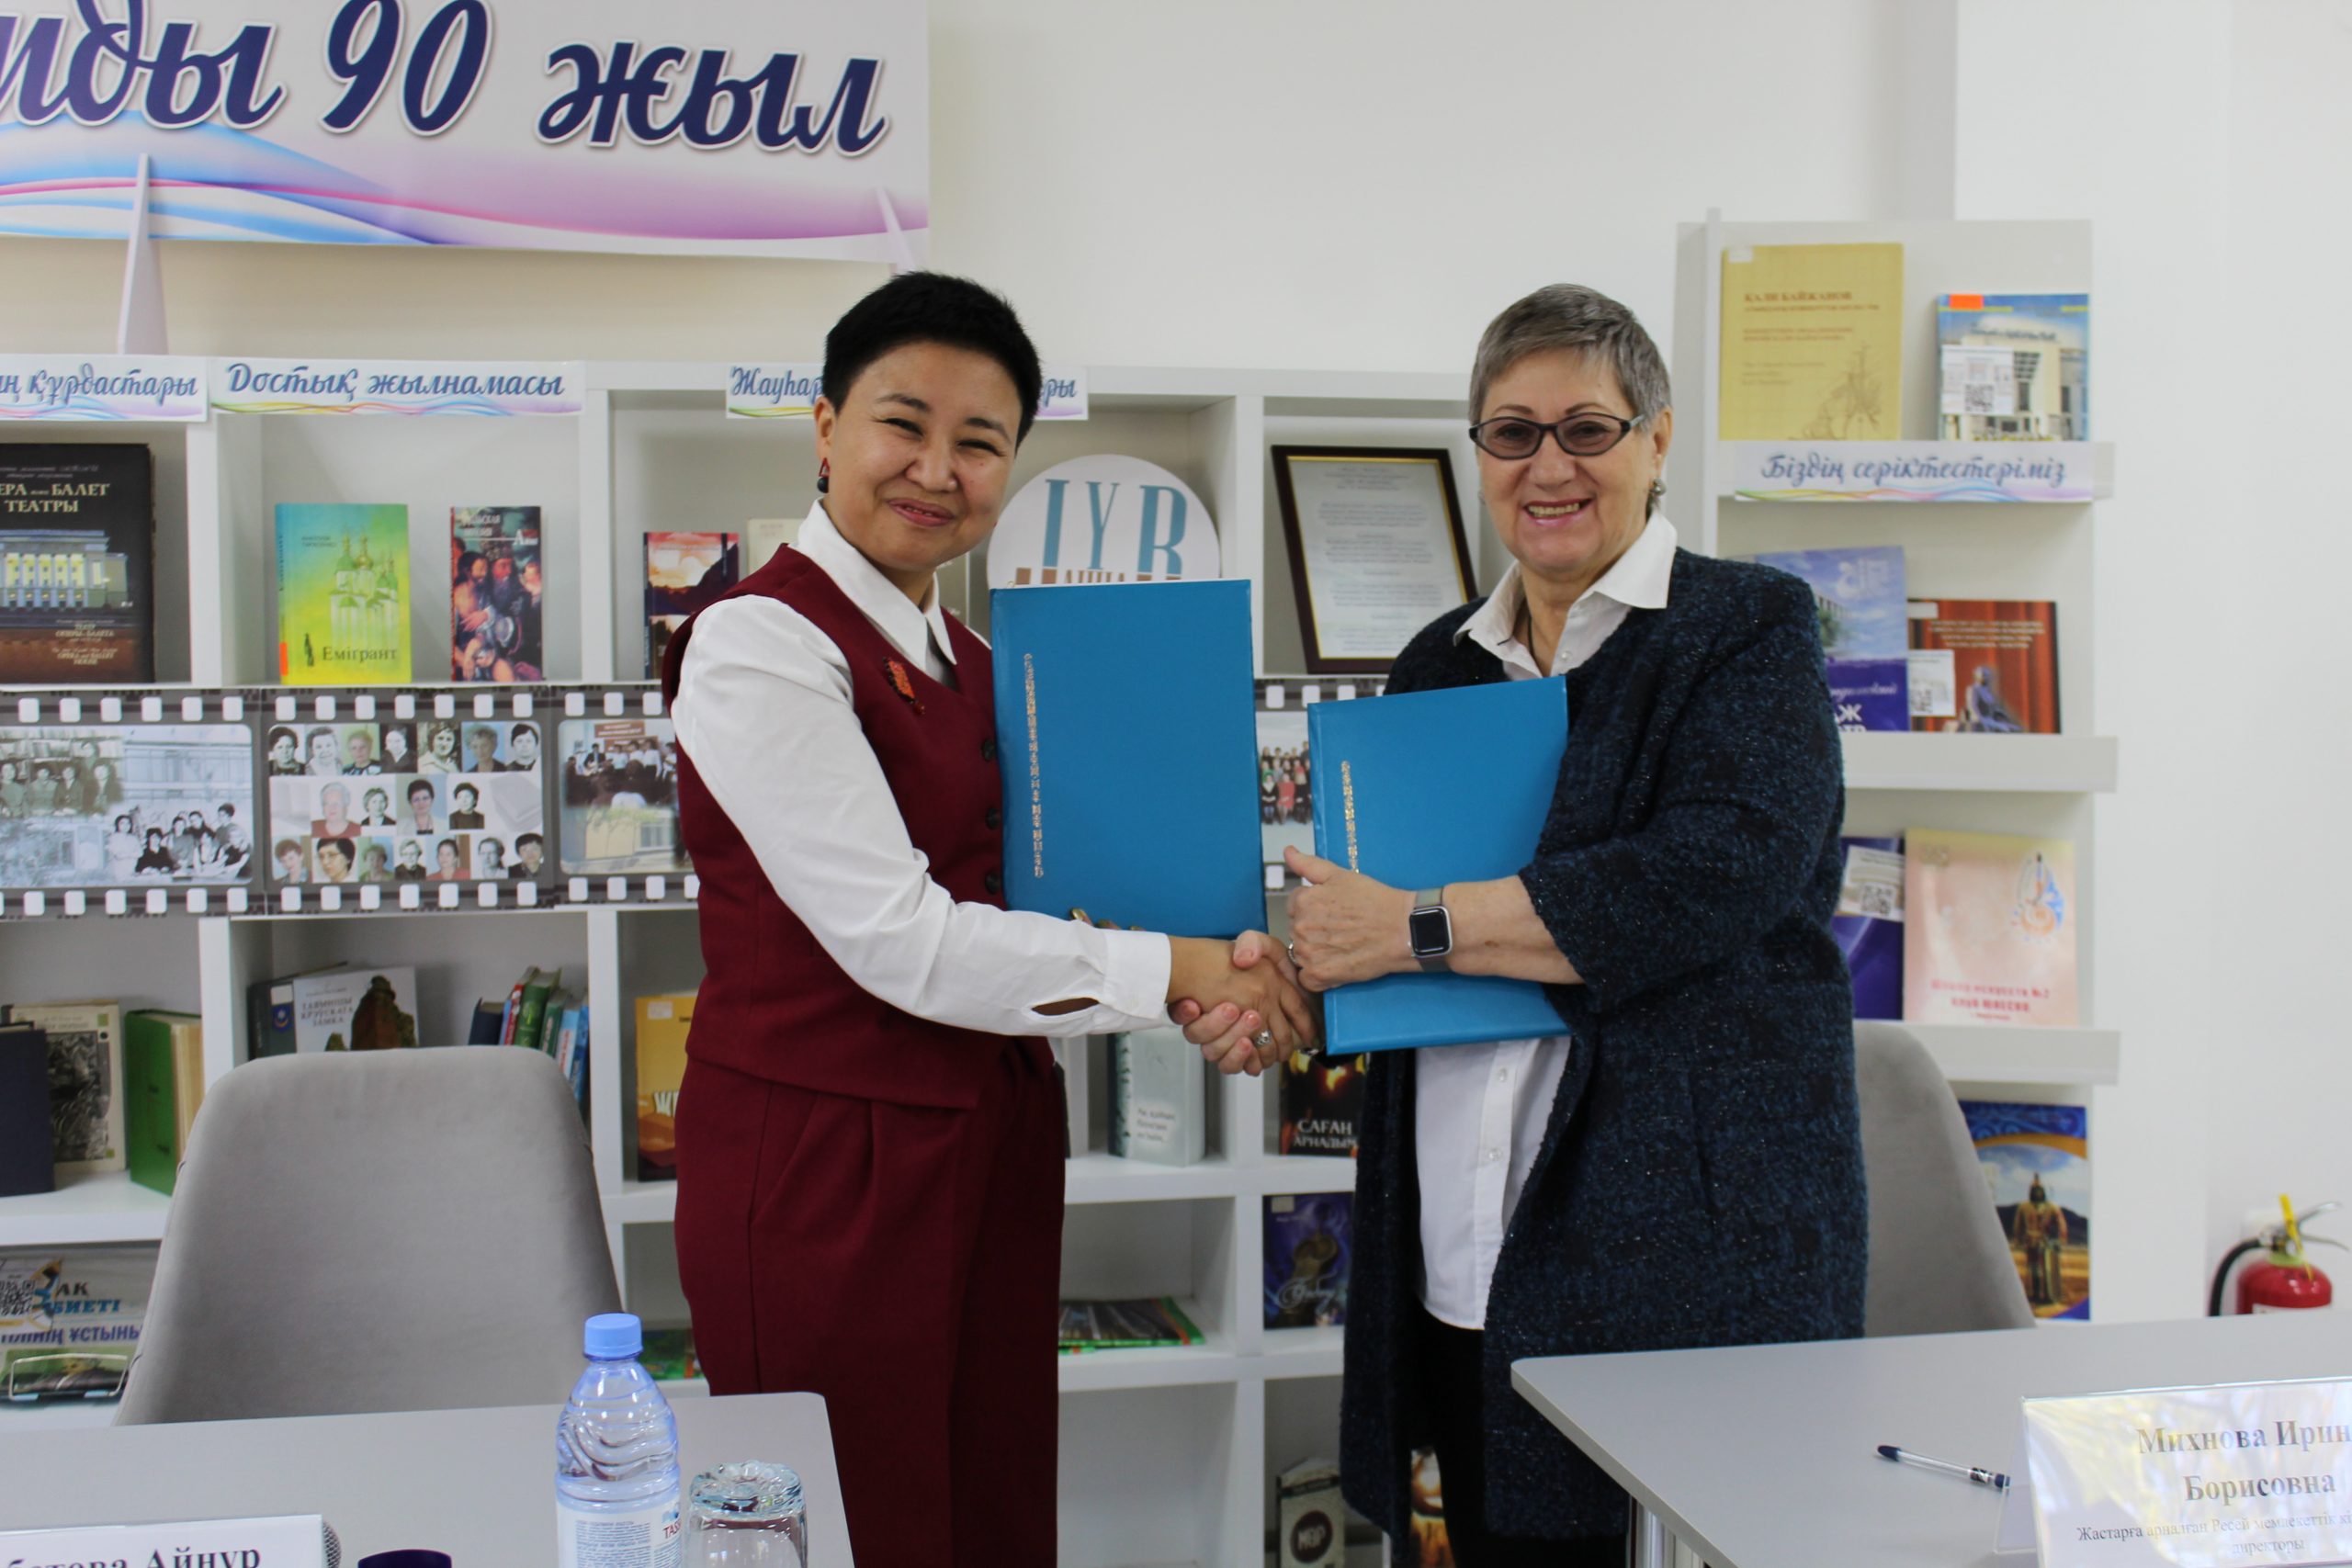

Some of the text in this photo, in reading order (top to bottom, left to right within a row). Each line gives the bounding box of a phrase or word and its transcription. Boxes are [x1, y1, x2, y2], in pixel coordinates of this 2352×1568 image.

[322, 0, 489, 132] 90
[540, 41, 888, 153] жыл
[28, 362, 198, 406] құрдастары
[228, 362, 566, 401] Достық жылнамасы
[1040, 378, 1079, 408] ры
[1761, 452, 2067, 490] Біздің серіктестеріміз
[51, 483, 110, 497] БАЛЕТ
[5, 500, 79, 513] ТЕАТРЫ
[2137, 1427, 2267, 1454] Михнова
[2183, 1474, 2335, 1506] Борисовна
[2076, 1526, 2143, 1541] Жастарға
[2211, 1516, 2250, 1532] Ресей
